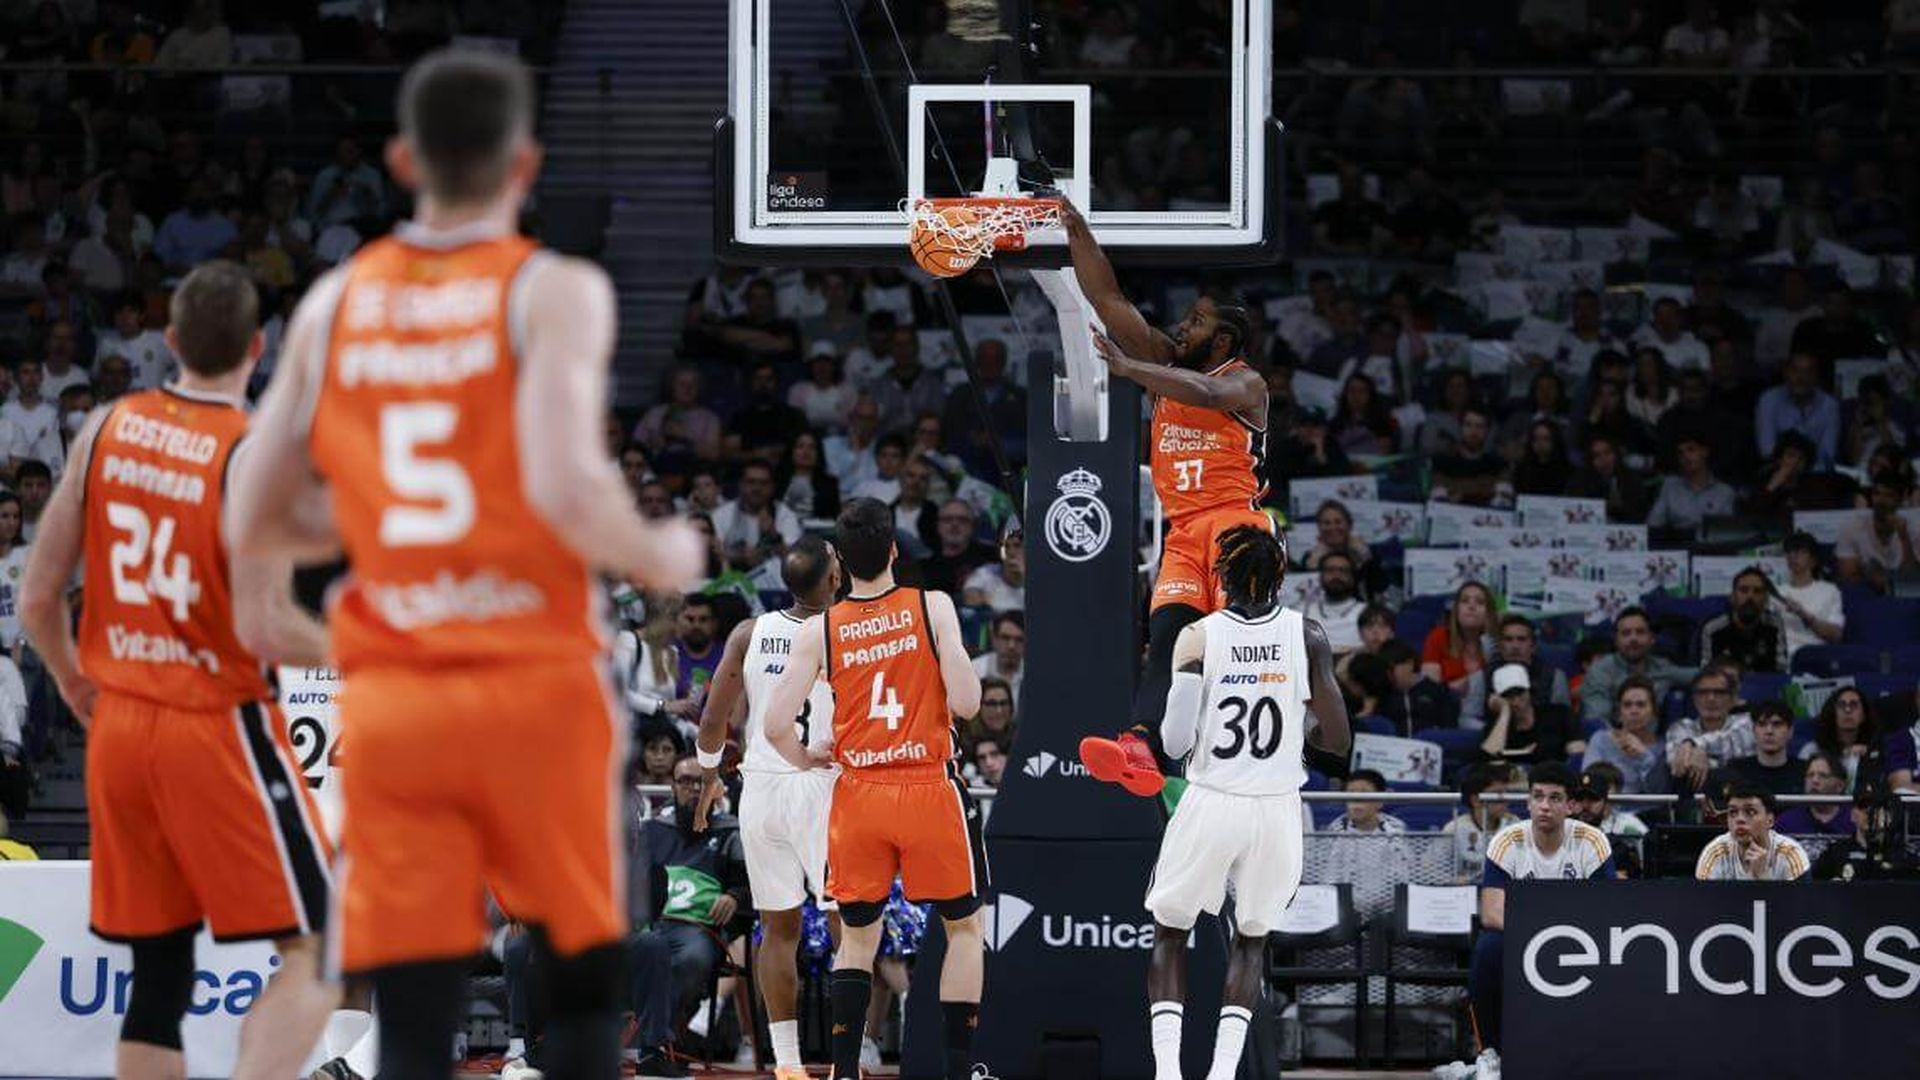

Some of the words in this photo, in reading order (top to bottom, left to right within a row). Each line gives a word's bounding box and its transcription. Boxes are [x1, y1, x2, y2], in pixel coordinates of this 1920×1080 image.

[770, 196, 825, 207] endesa
[116, 411, 218, 466] COSTELLO
[377, 402, 478, 548] 5
[1173, 459, 1204, 491] 37
[106, 501, 201, 623] 24
[838, 610, 913, 643] PRADILLA
[842, 634, 918, 668] PAMESA
[867, 671, 905, 730] 4
[1211, 696, 1283, 760] 30
[1523, 900, 1920, 999] endes
